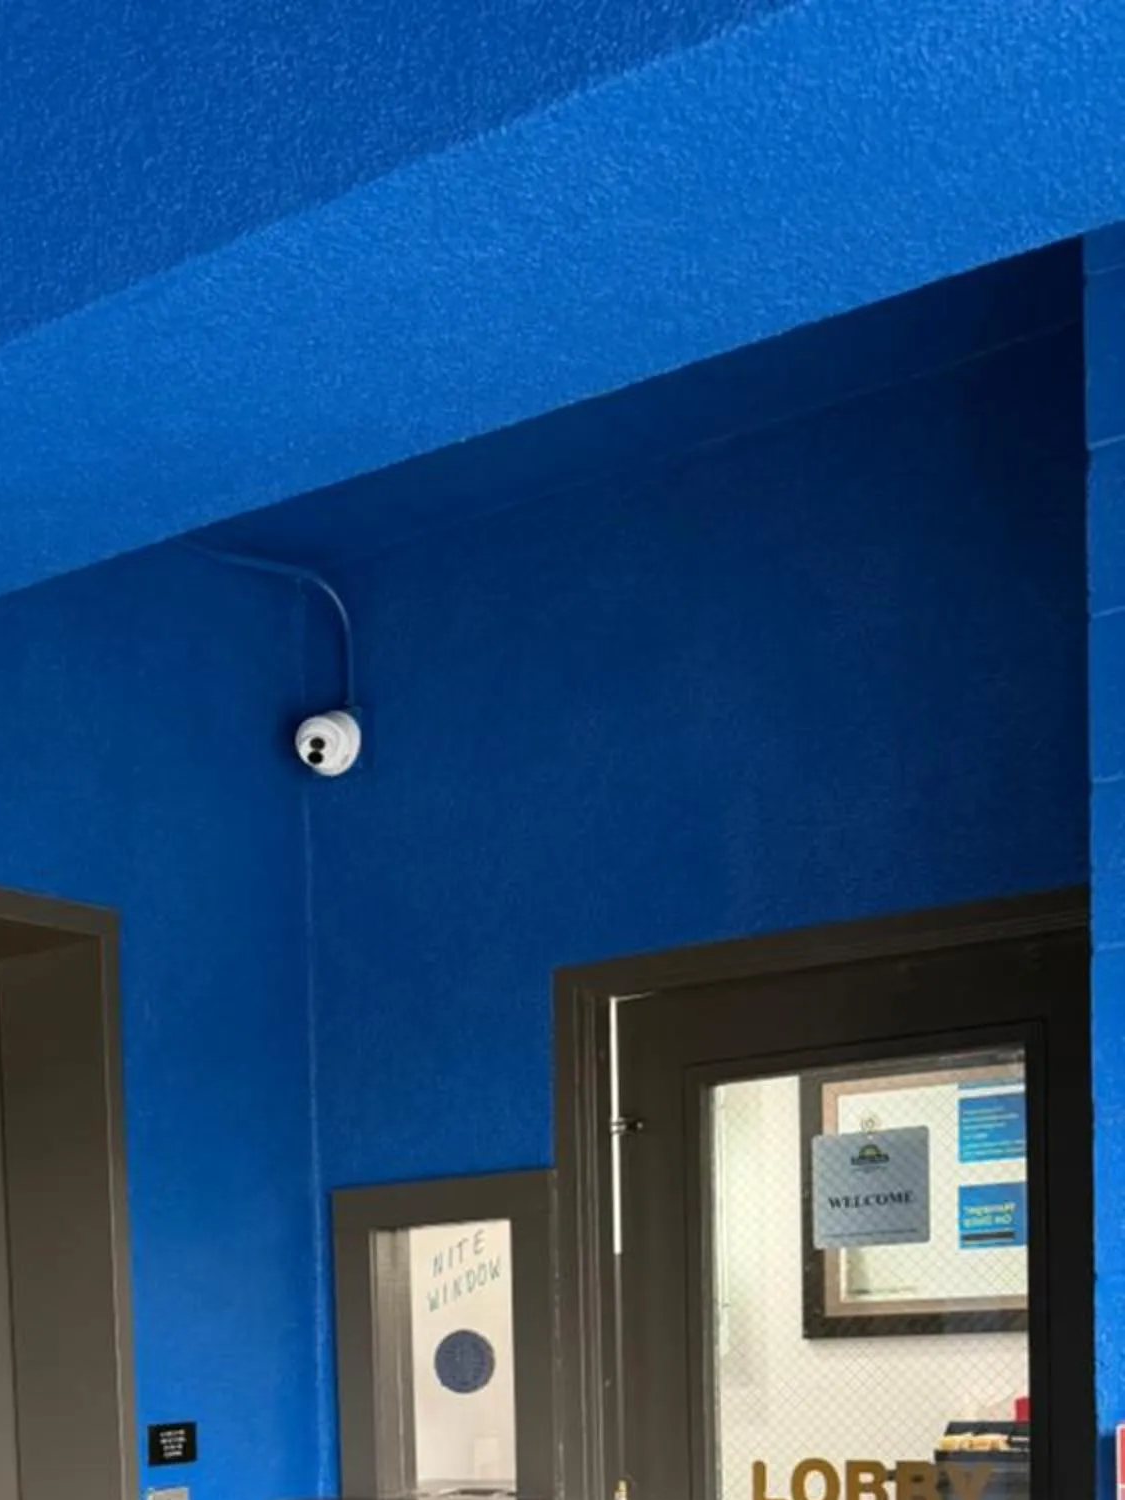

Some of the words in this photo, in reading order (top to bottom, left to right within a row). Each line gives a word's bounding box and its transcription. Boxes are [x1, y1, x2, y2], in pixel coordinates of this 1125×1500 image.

[827, 1189, 914, 1210] WELCOME
[432, 1228, 486, 1278] NITE
[427, 1256, 502, 1312] WINDOW
